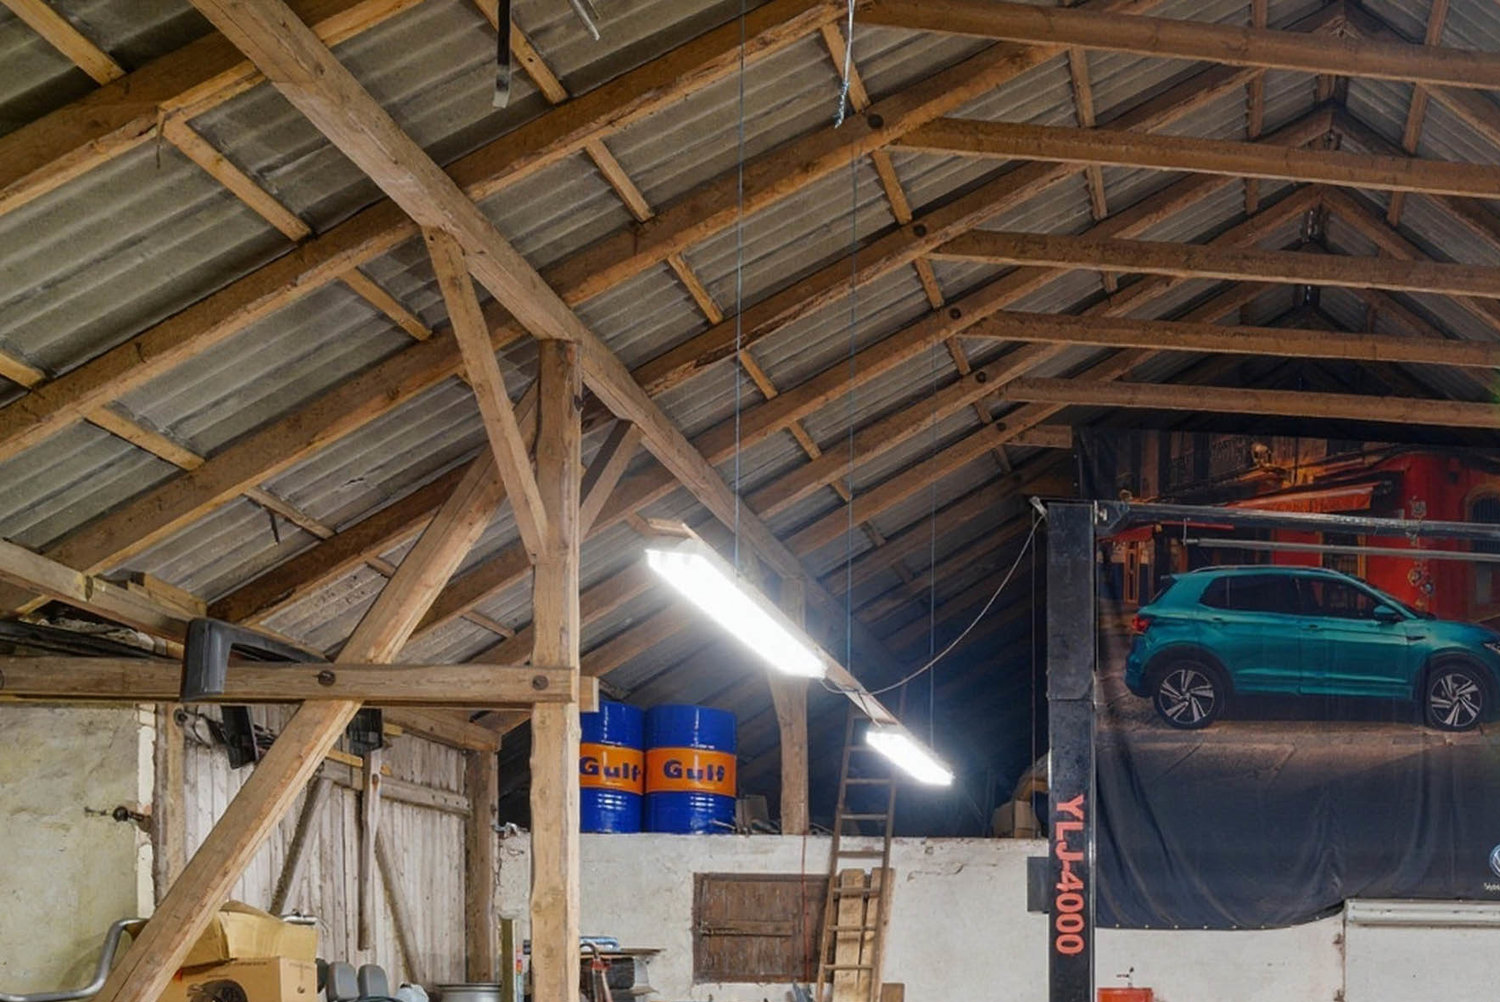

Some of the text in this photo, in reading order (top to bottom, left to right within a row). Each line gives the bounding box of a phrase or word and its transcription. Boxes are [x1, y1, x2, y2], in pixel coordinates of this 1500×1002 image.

[579, 756, 642, 782] Gulf
[663, 759, 726, 782] Gulf
[1055, 794, 1085, 955] YLJ-4000
